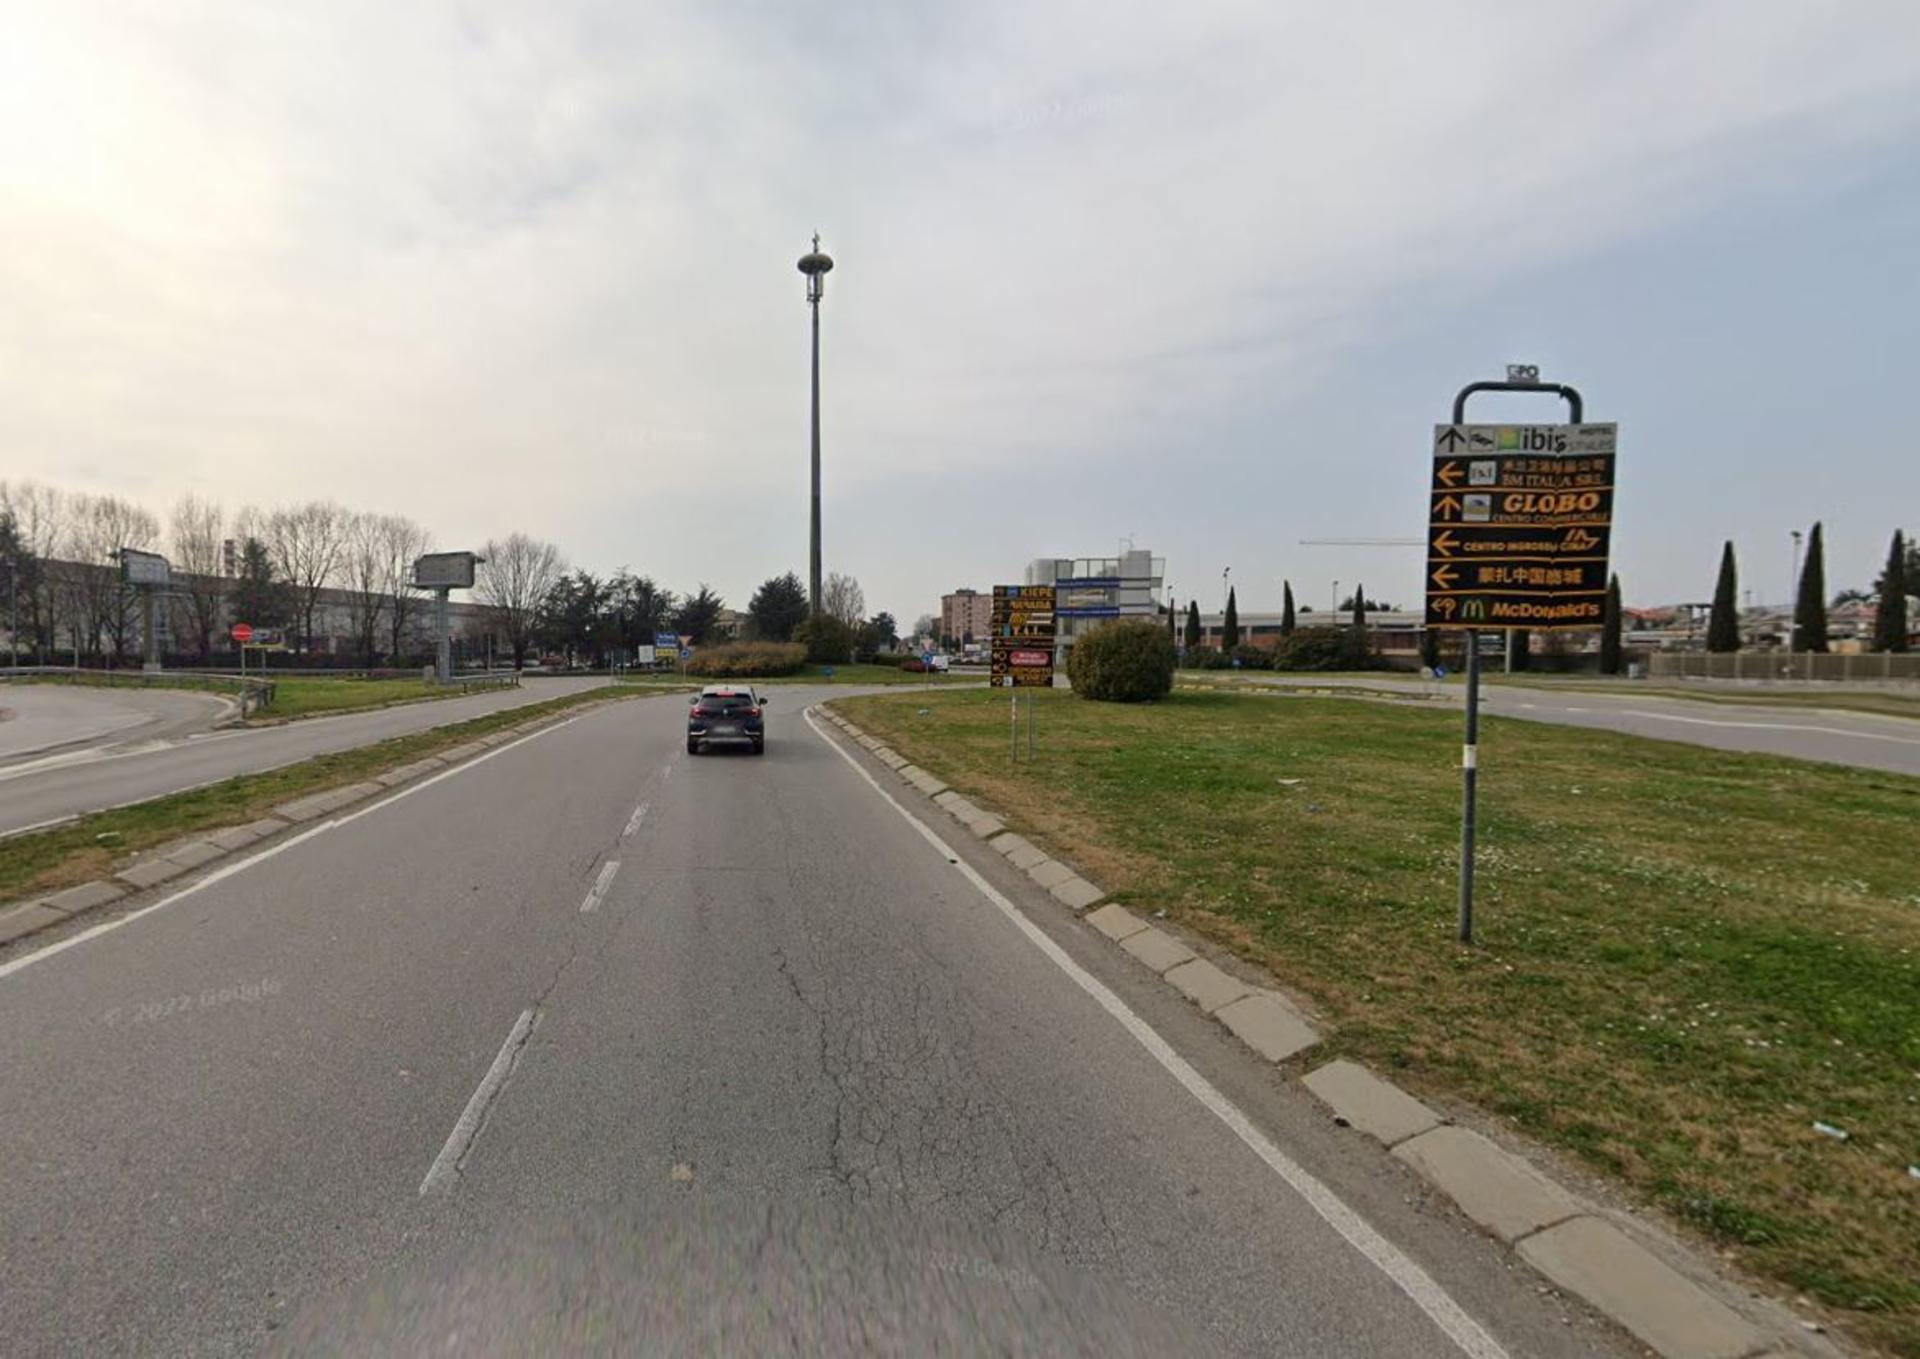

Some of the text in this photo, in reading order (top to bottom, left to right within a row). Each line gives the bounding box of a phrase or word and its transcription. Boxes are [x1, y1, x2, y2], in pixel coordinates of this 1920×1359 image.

[1522, 428, 1567, 451] ibis
[1503, 493, 1600, 514] GLOBO
[1463, 542, 1505, 551] CENTRO
[1491, 602, 1600, 618] McDonald's
